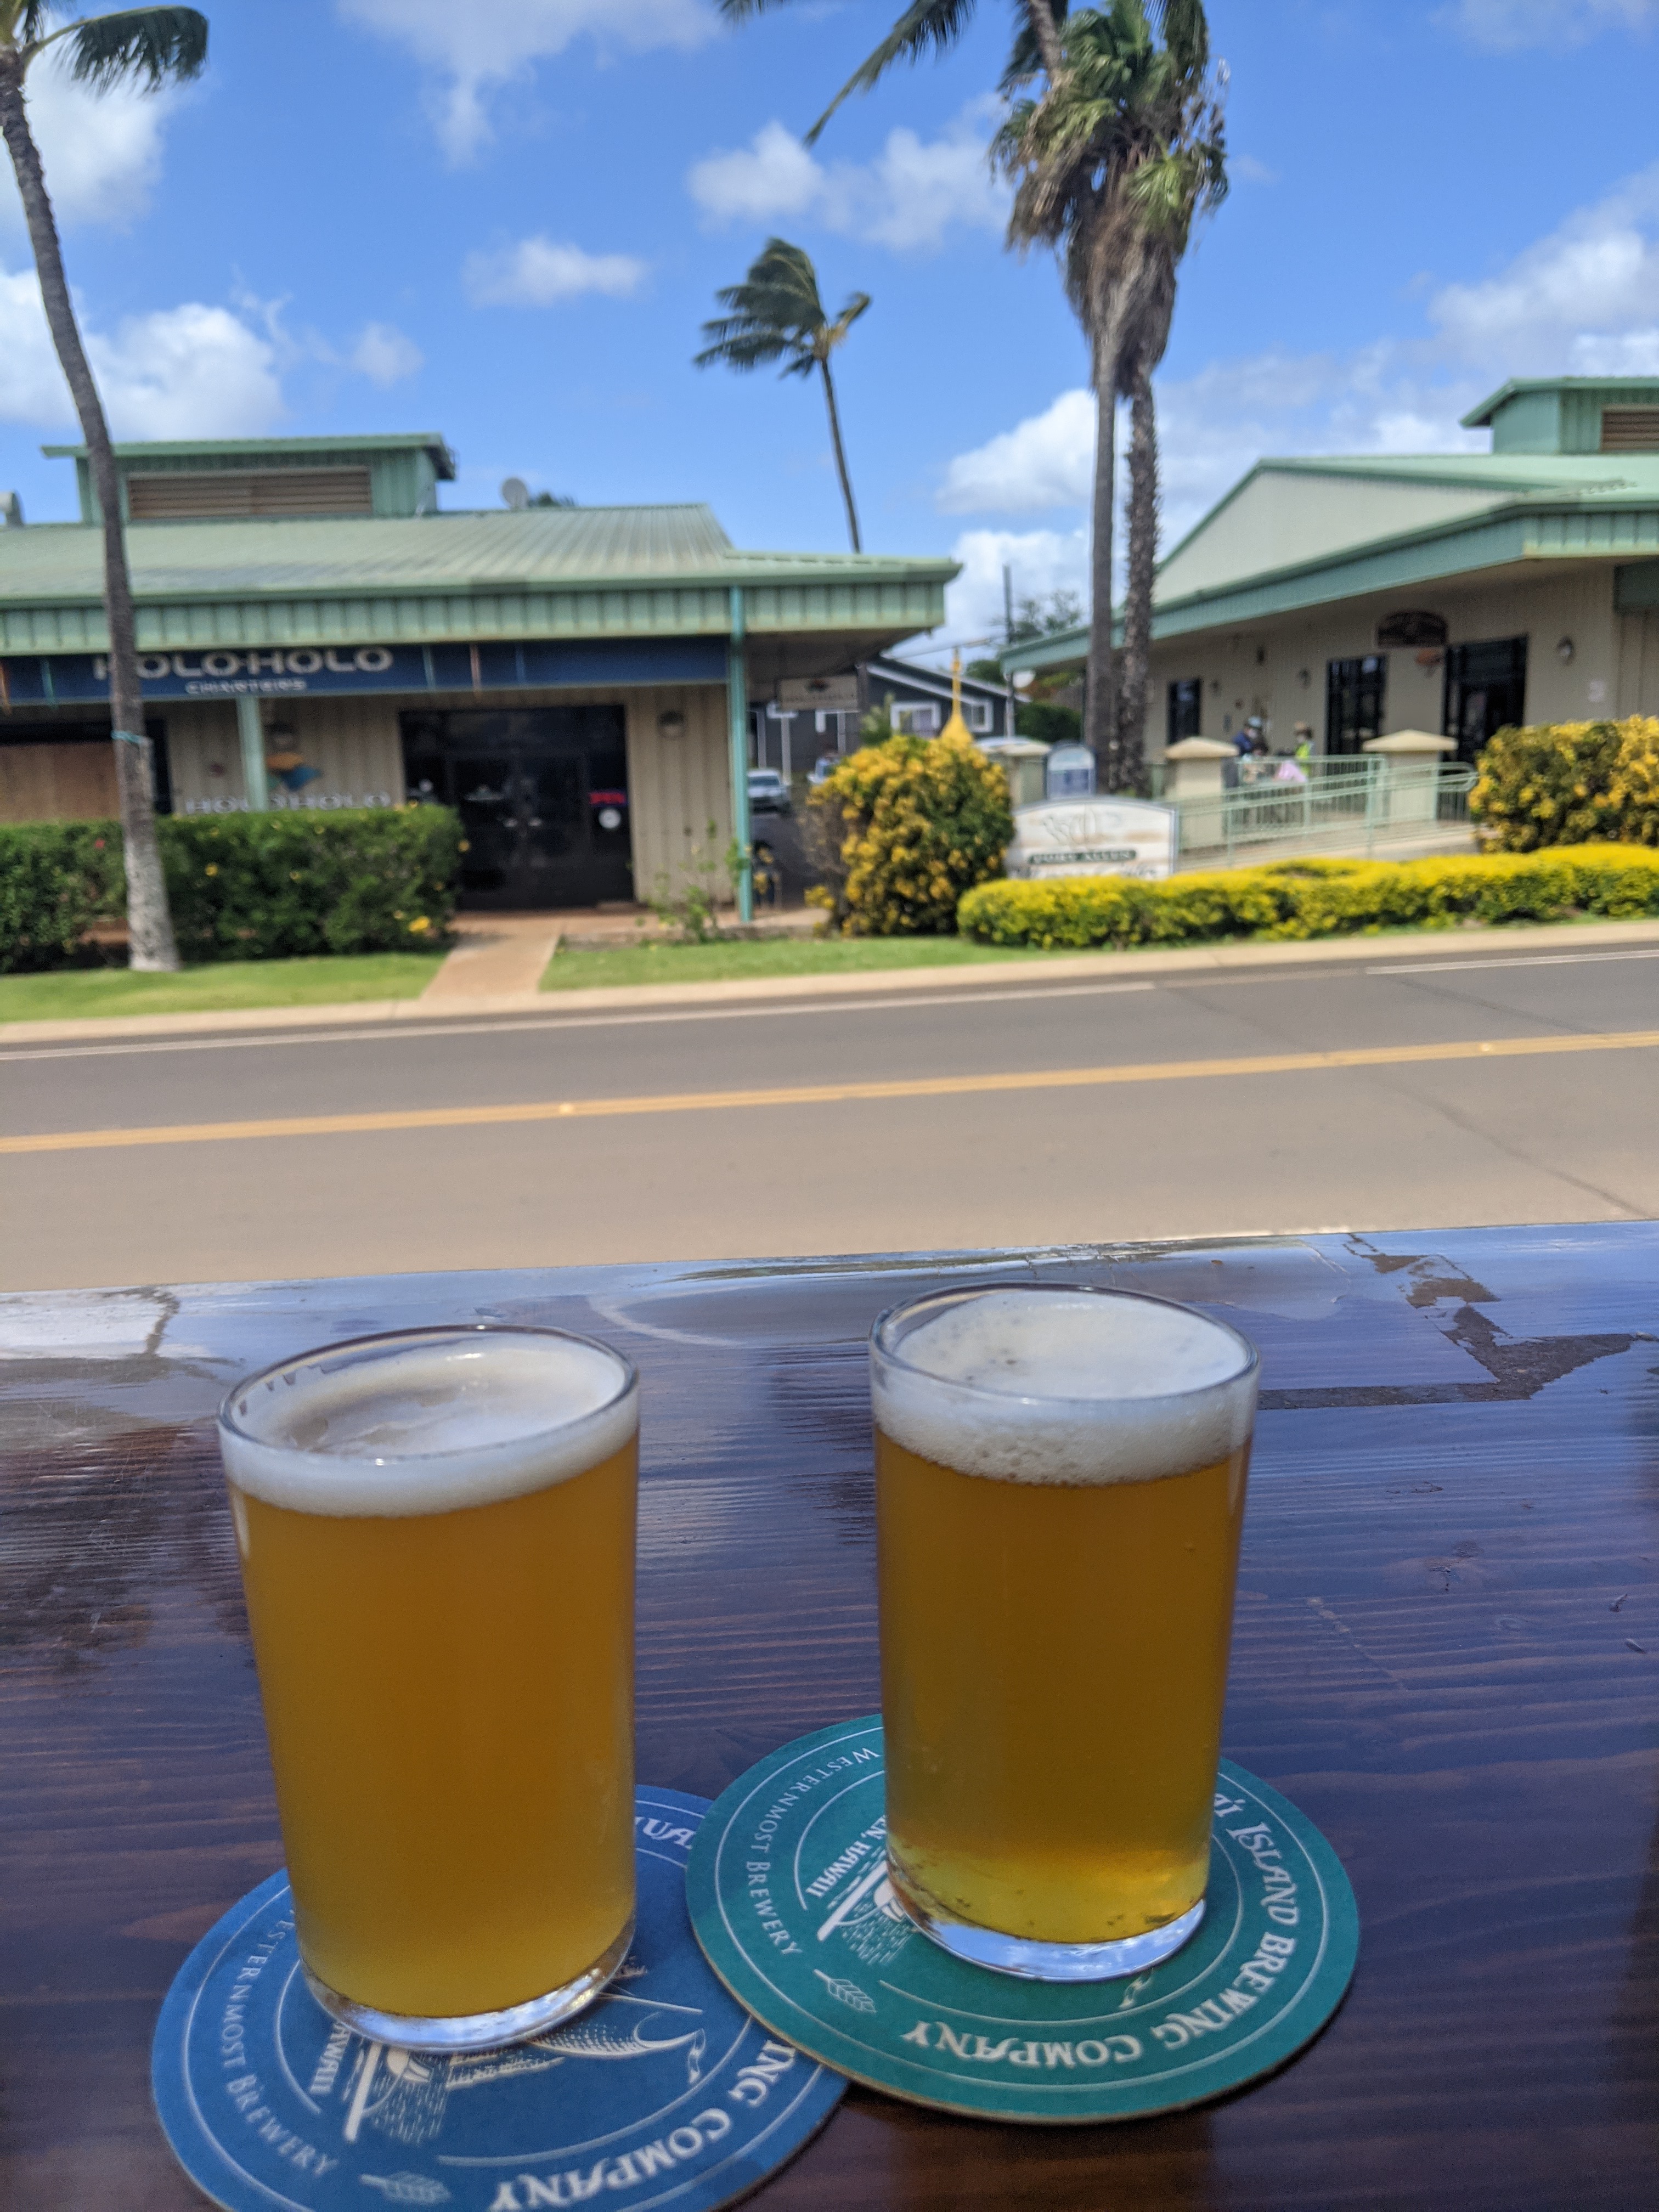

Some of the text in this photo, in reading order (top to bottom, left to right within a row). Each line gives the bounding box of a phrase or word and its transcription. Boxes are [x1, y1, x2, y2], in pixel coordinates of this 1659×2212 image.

[751, 1748, 880, 1853] WESTERNMOST
[746, 1861, 803, 1955] BREWERY
[805, 1841, 873, 1898] HAWAII
[1226, 1822, 1300, 1926] ISLAND
[222, 1909, 340, 2176] ESTERNMOST BREWERY
[1150, 1931, 1296, 2050] BREWING
[308, 2022, 352, 2095] AWAII
[899, 2021, 1143, 2069] COMPANY
[487, 2108, 731, 2212] COMPANY
